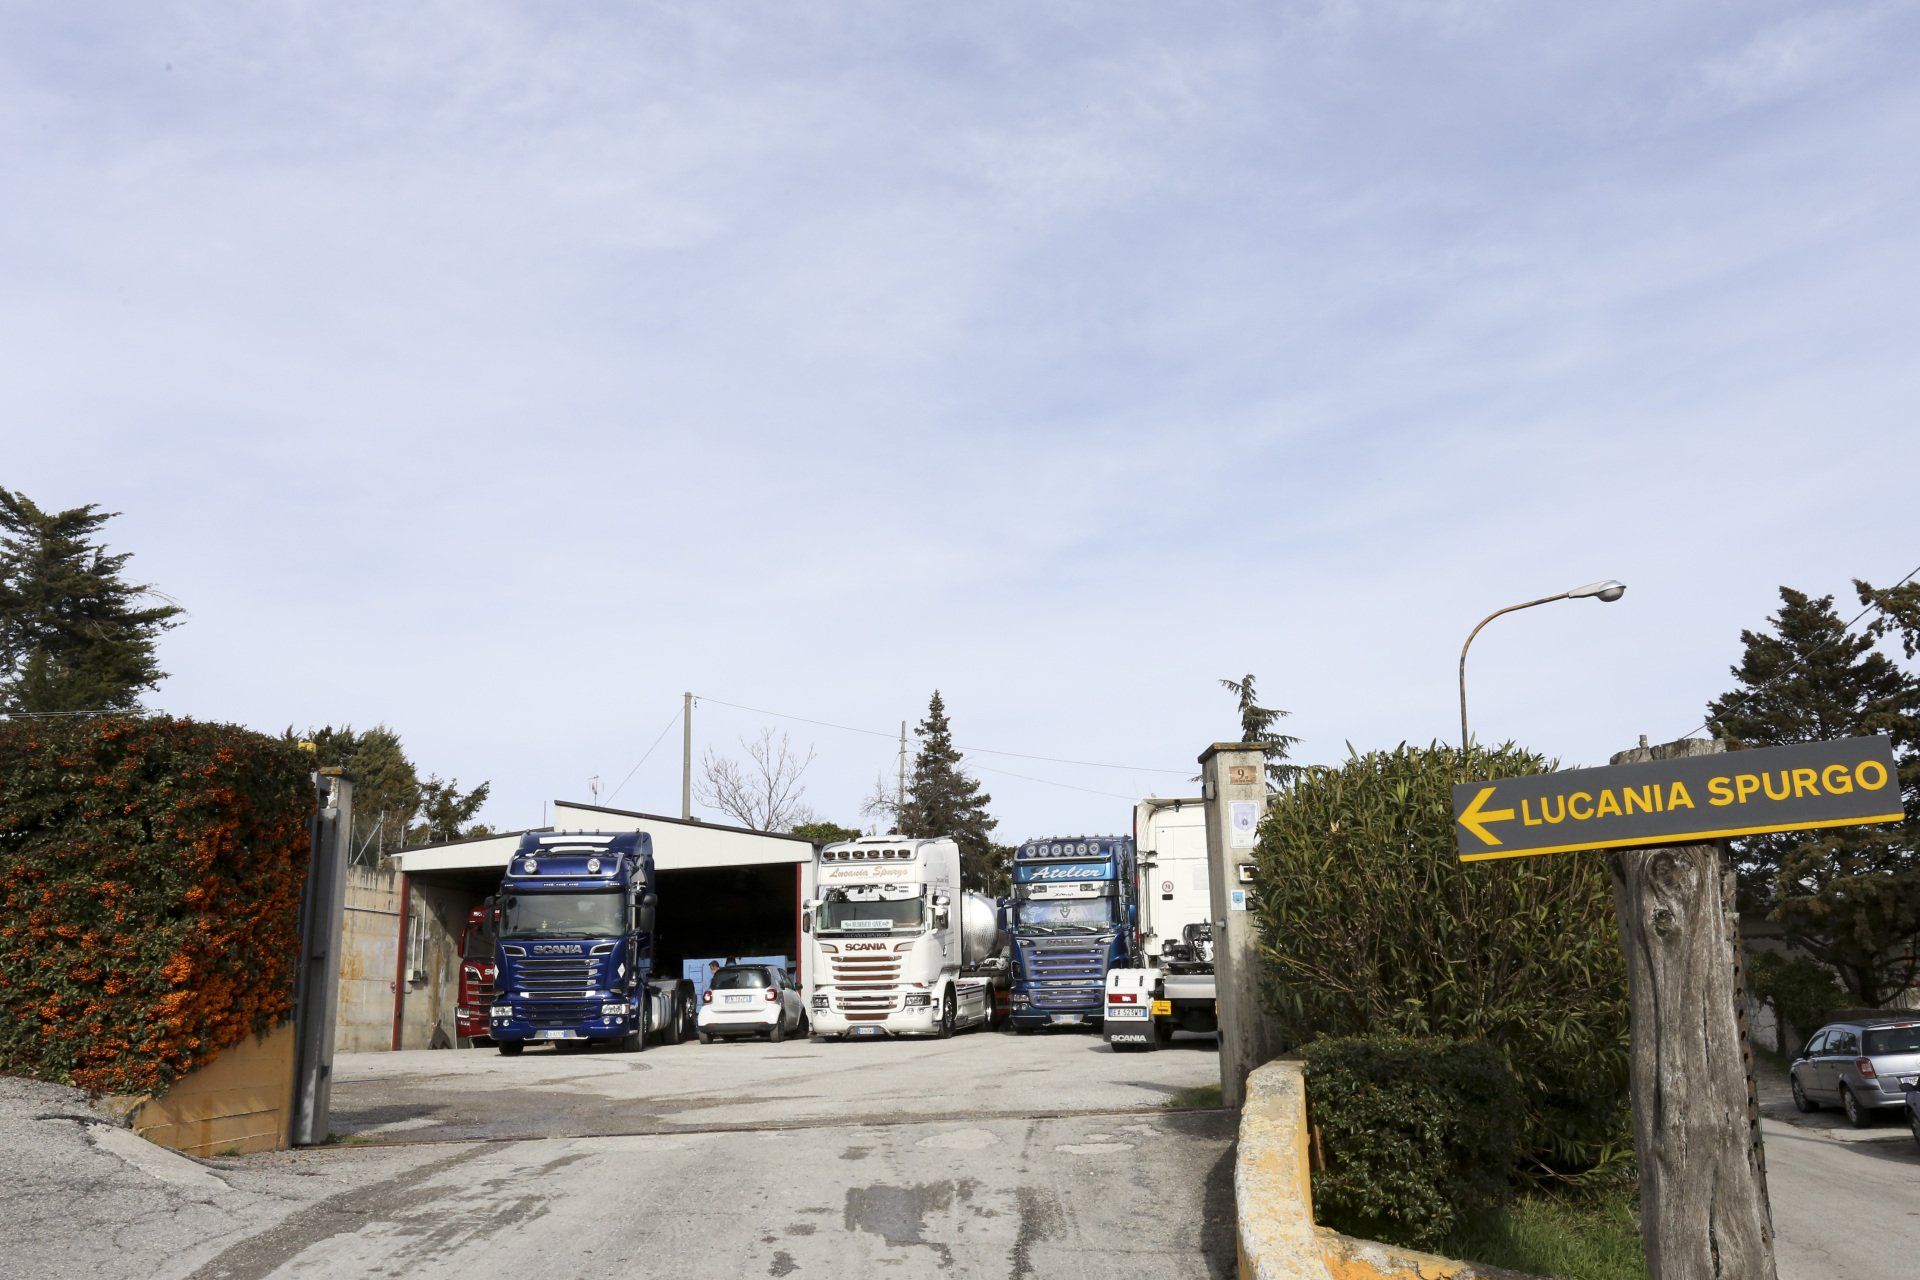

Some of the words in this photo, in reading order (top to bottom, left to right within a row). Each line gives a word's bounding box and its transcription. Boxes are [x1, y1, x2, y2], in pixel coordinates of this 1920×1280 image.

[1521, 781, 1695, 826] LUCANIA
[1707, 760, 1888, 806] SPURGO
[829, 868, 868, 878] Lucania
[1030, 866, 1102, 880] Atelier
[533, 945, 583, 954] SCANIA
[845, 943, 887, 951] SCANIA
[1111, 1034, 1147, 1042] SCANIA
